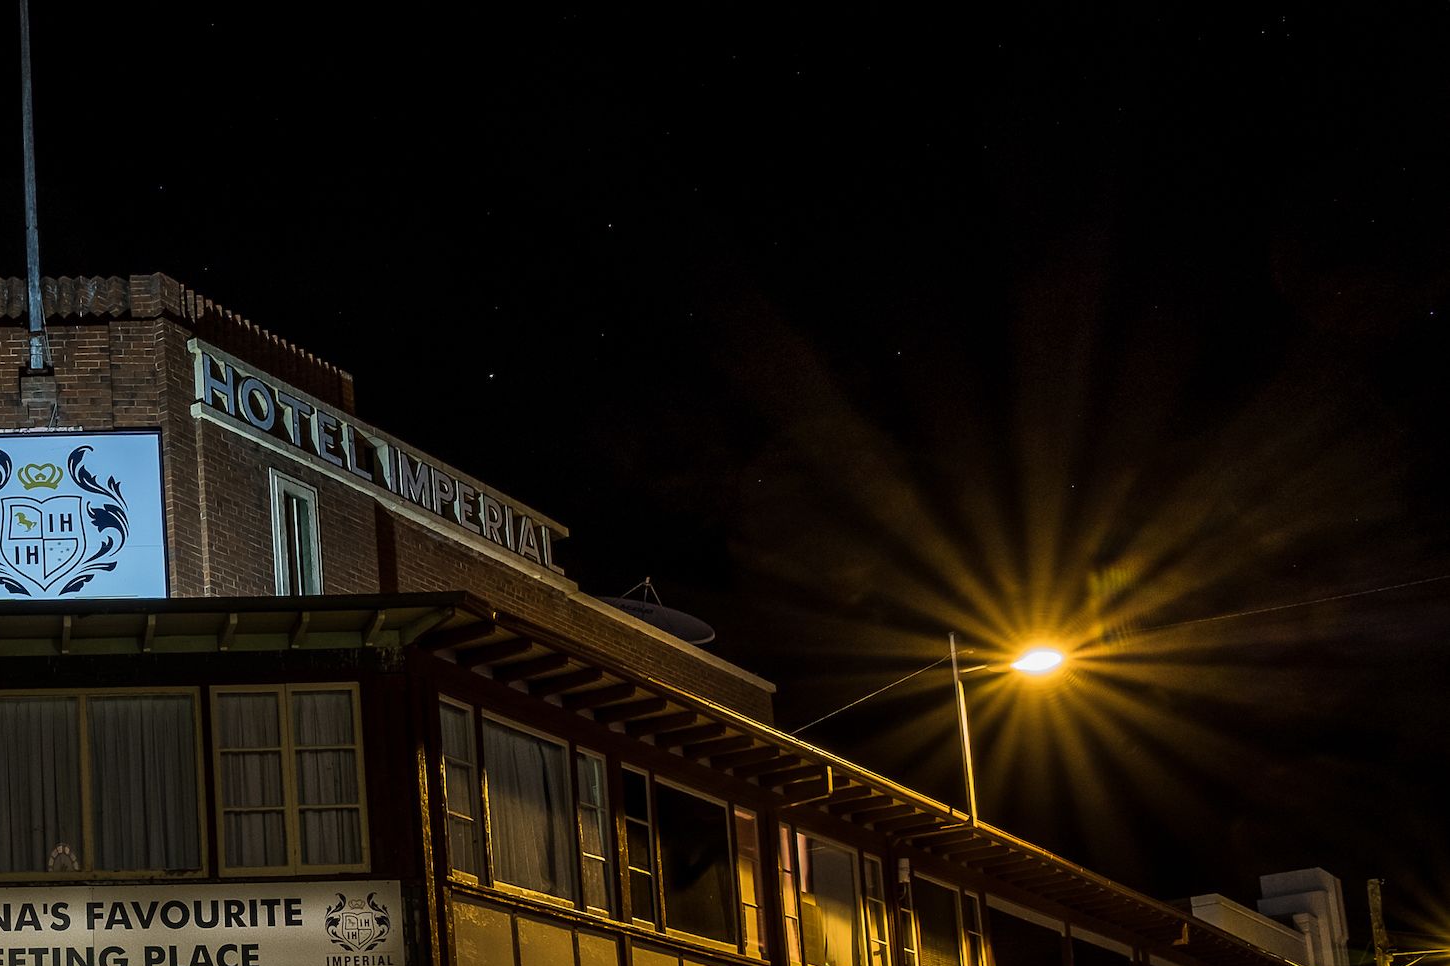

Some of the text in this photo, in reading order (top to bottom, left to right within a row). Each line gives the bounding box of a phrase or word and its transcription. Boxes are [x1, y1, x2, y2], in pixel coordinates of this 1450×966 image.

[201, 350, 565, 576] HOTEL IMPERIAL
[49, 513, 73, 533] IH
[14, 545, 39, 565] IH
[86, 898, 303, 931] FAVOURITE
[326, 955, 394, 966] IMPERIAL
